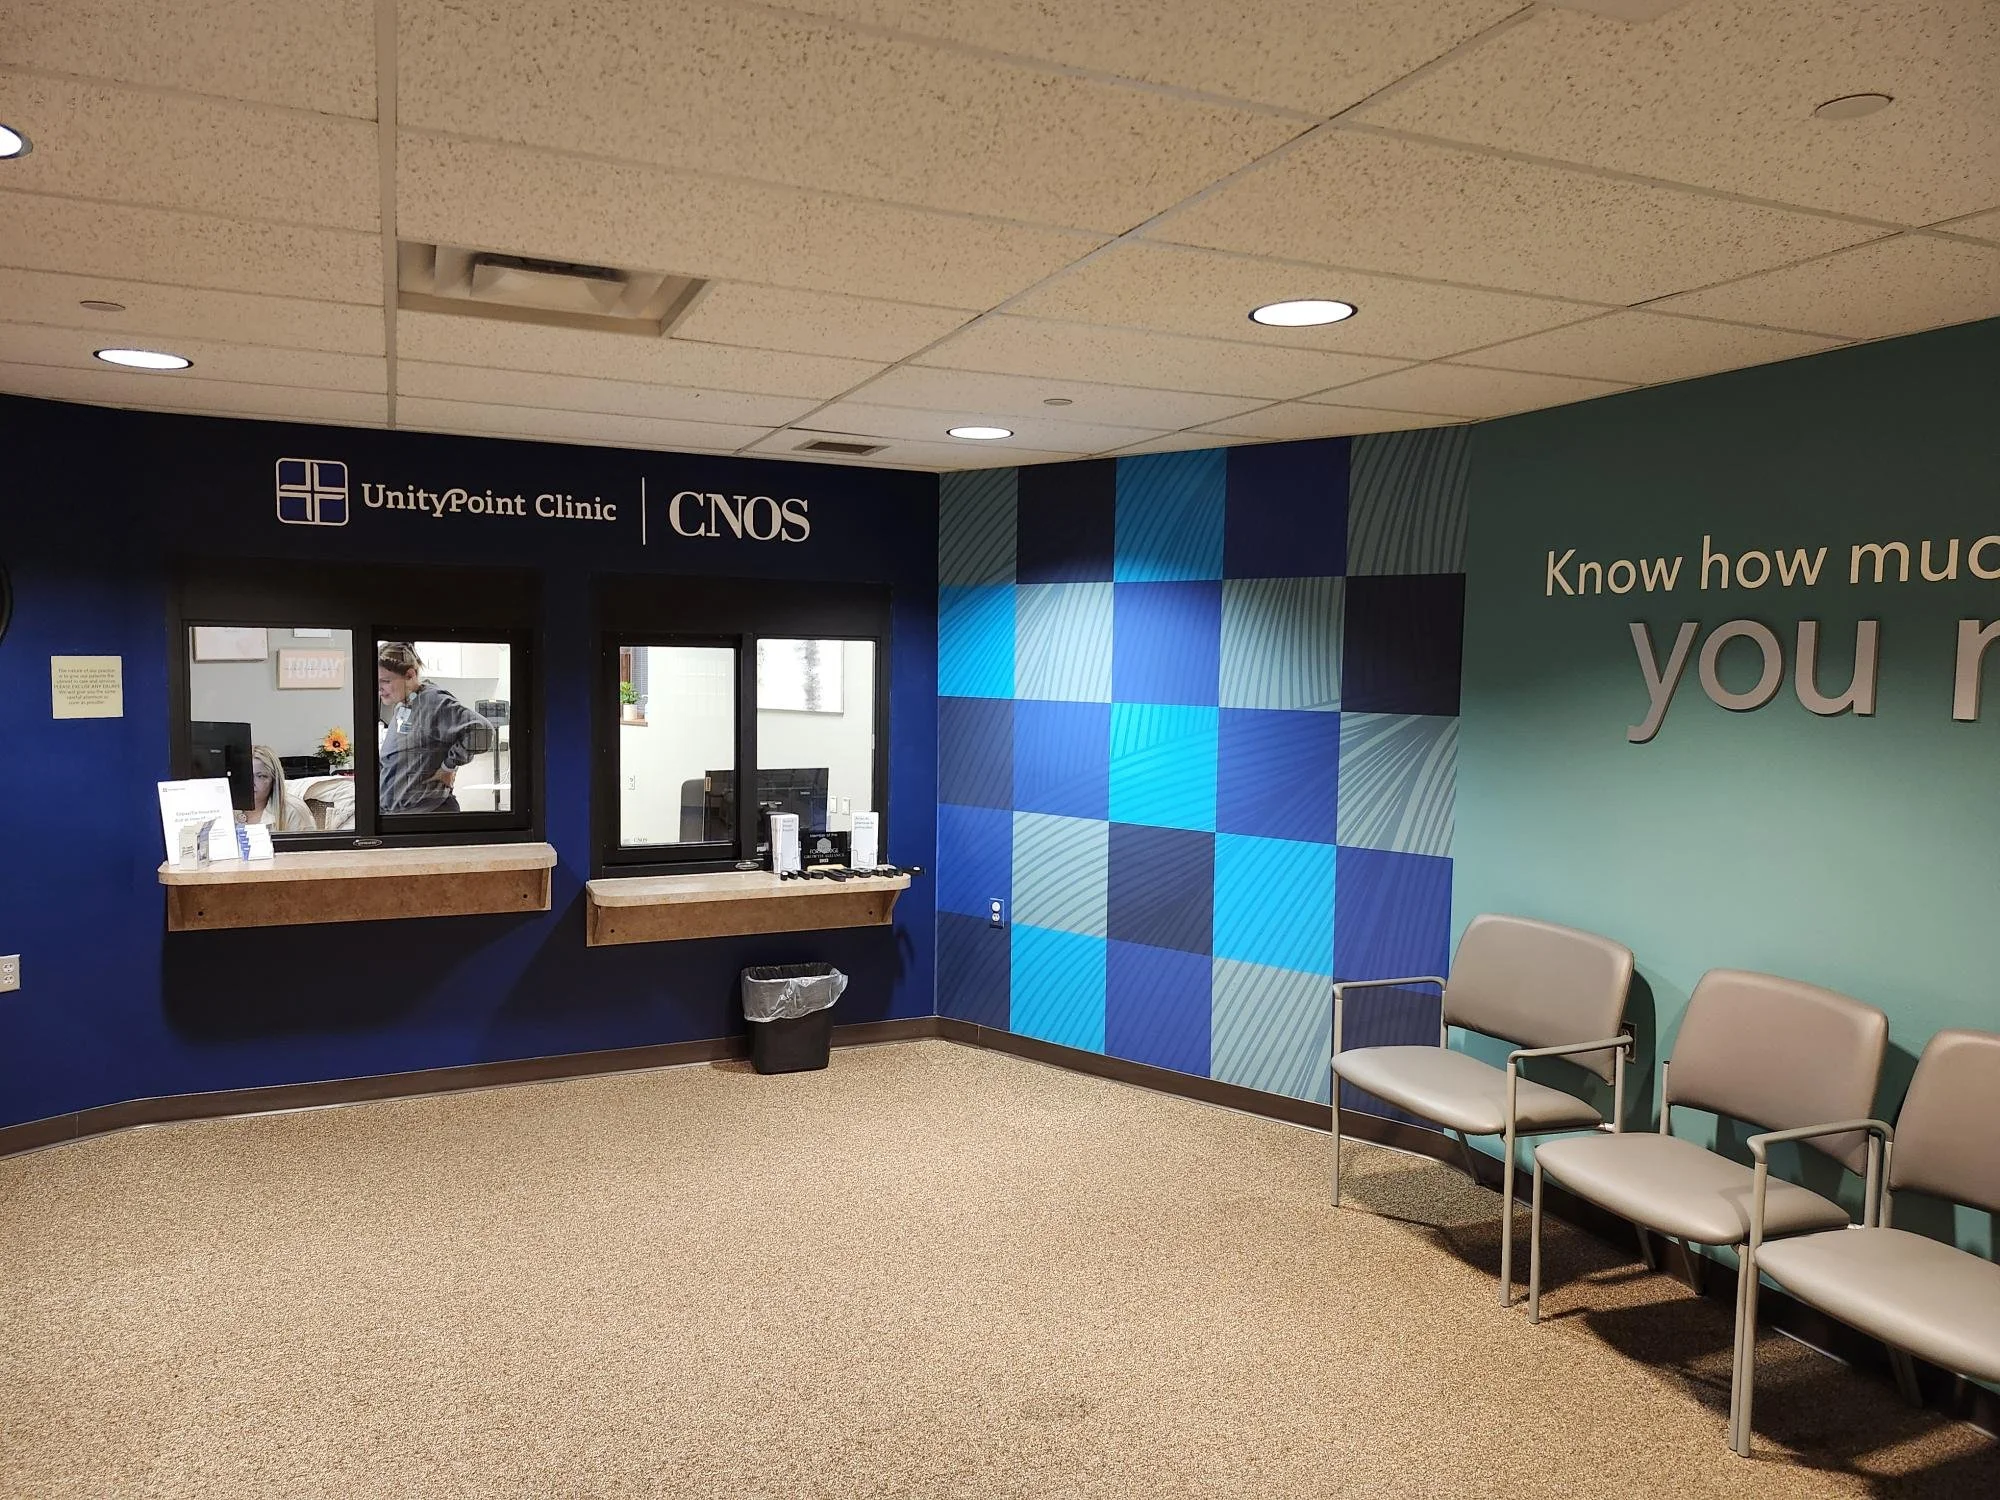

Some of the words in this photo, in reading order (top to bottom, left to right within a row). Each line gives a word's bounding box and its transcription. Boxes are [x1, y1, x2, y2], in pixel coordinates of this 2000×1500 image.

[361, 483, 527, 516] UnityPoint
[535, 494, 617, 521] Clinic
[669, 491, 811, 543] CNOS
[1546, 549, 1683, 597] Know
[1700, 534, 1828, 590] how
[1627, 619, 1880, 742] you
